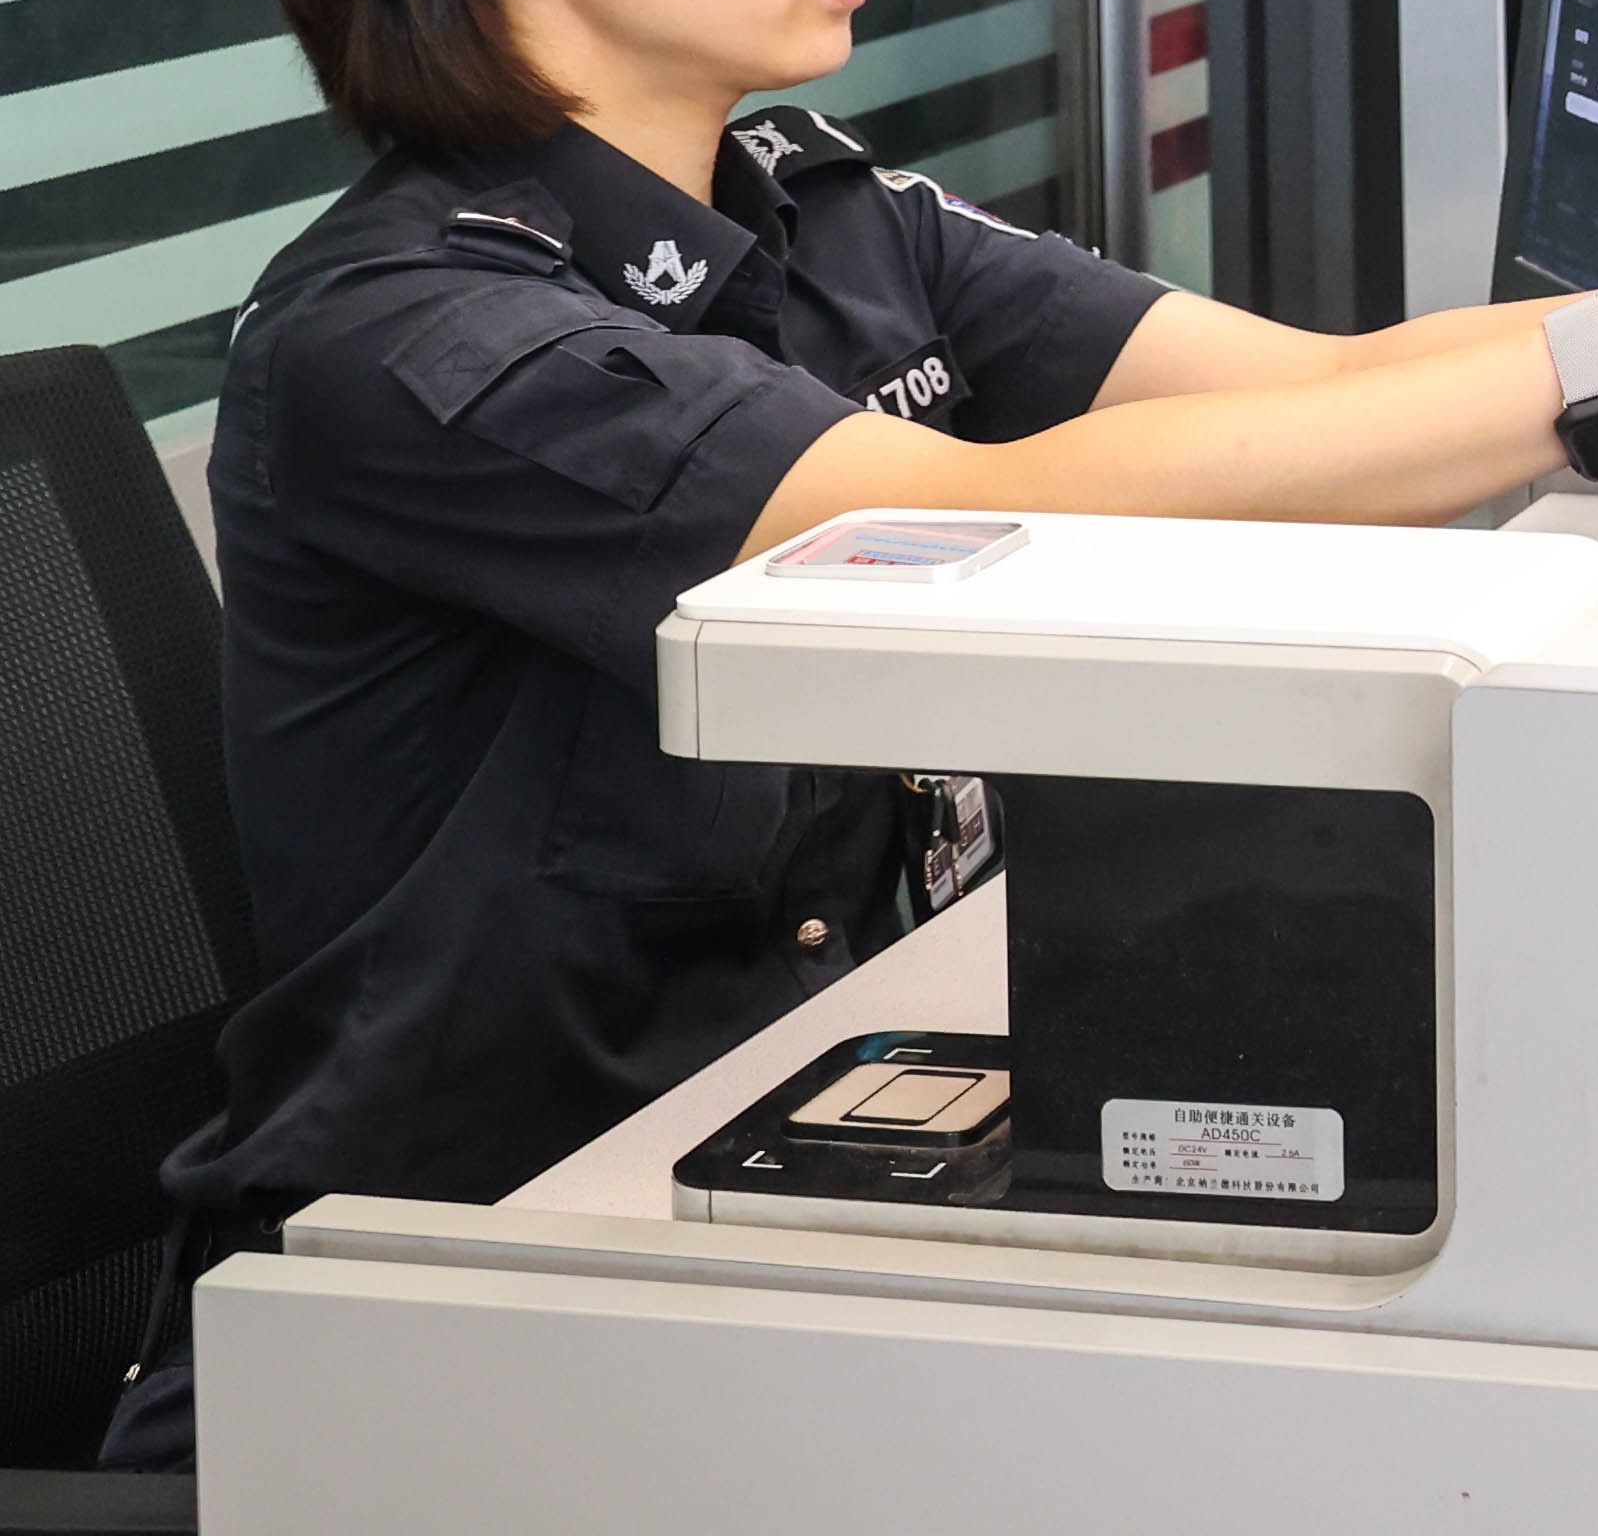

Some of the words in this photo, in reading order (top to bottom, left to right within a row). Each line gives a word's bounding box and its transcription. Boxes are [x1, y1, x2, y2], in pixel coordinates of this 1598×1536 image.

[1174, 1107, 1296, 1128] 自助便捷通关设备
[1201, 1127, 1261, 1142] AD450C
